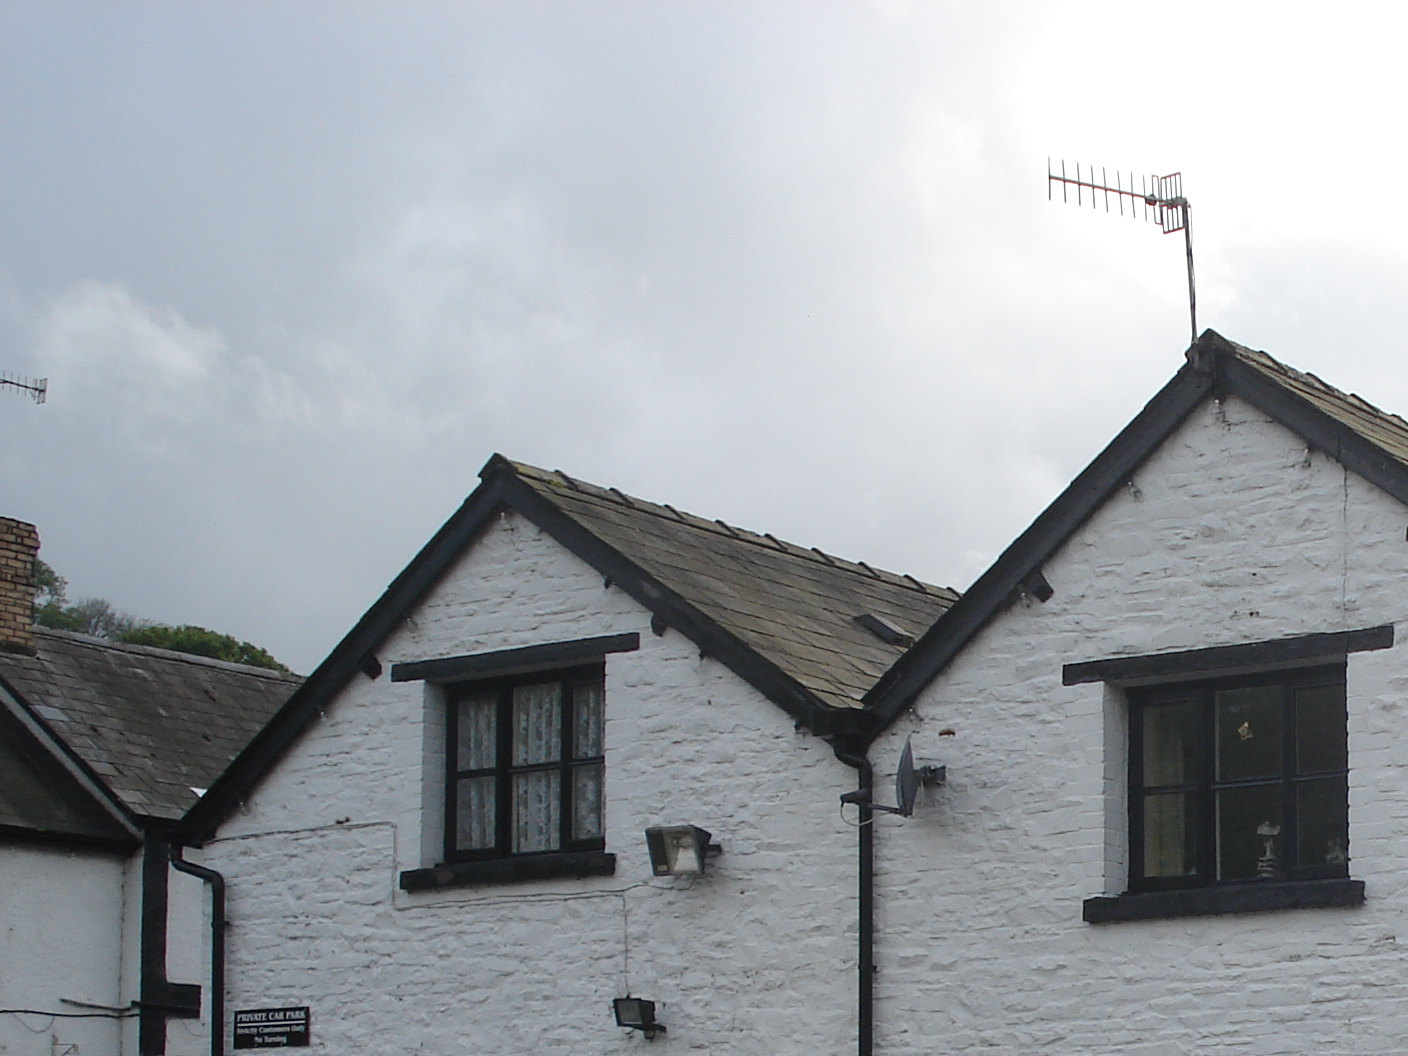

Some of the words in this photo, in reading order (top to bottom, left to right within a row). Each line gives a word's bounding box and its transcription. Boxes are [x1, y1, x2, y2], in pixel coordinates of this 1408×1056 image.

[237, 1013, 267, 1022] PRIVATE
[269, 1011, 284, 1020] CAR
[285, 1011, 305, 1019] PARK
